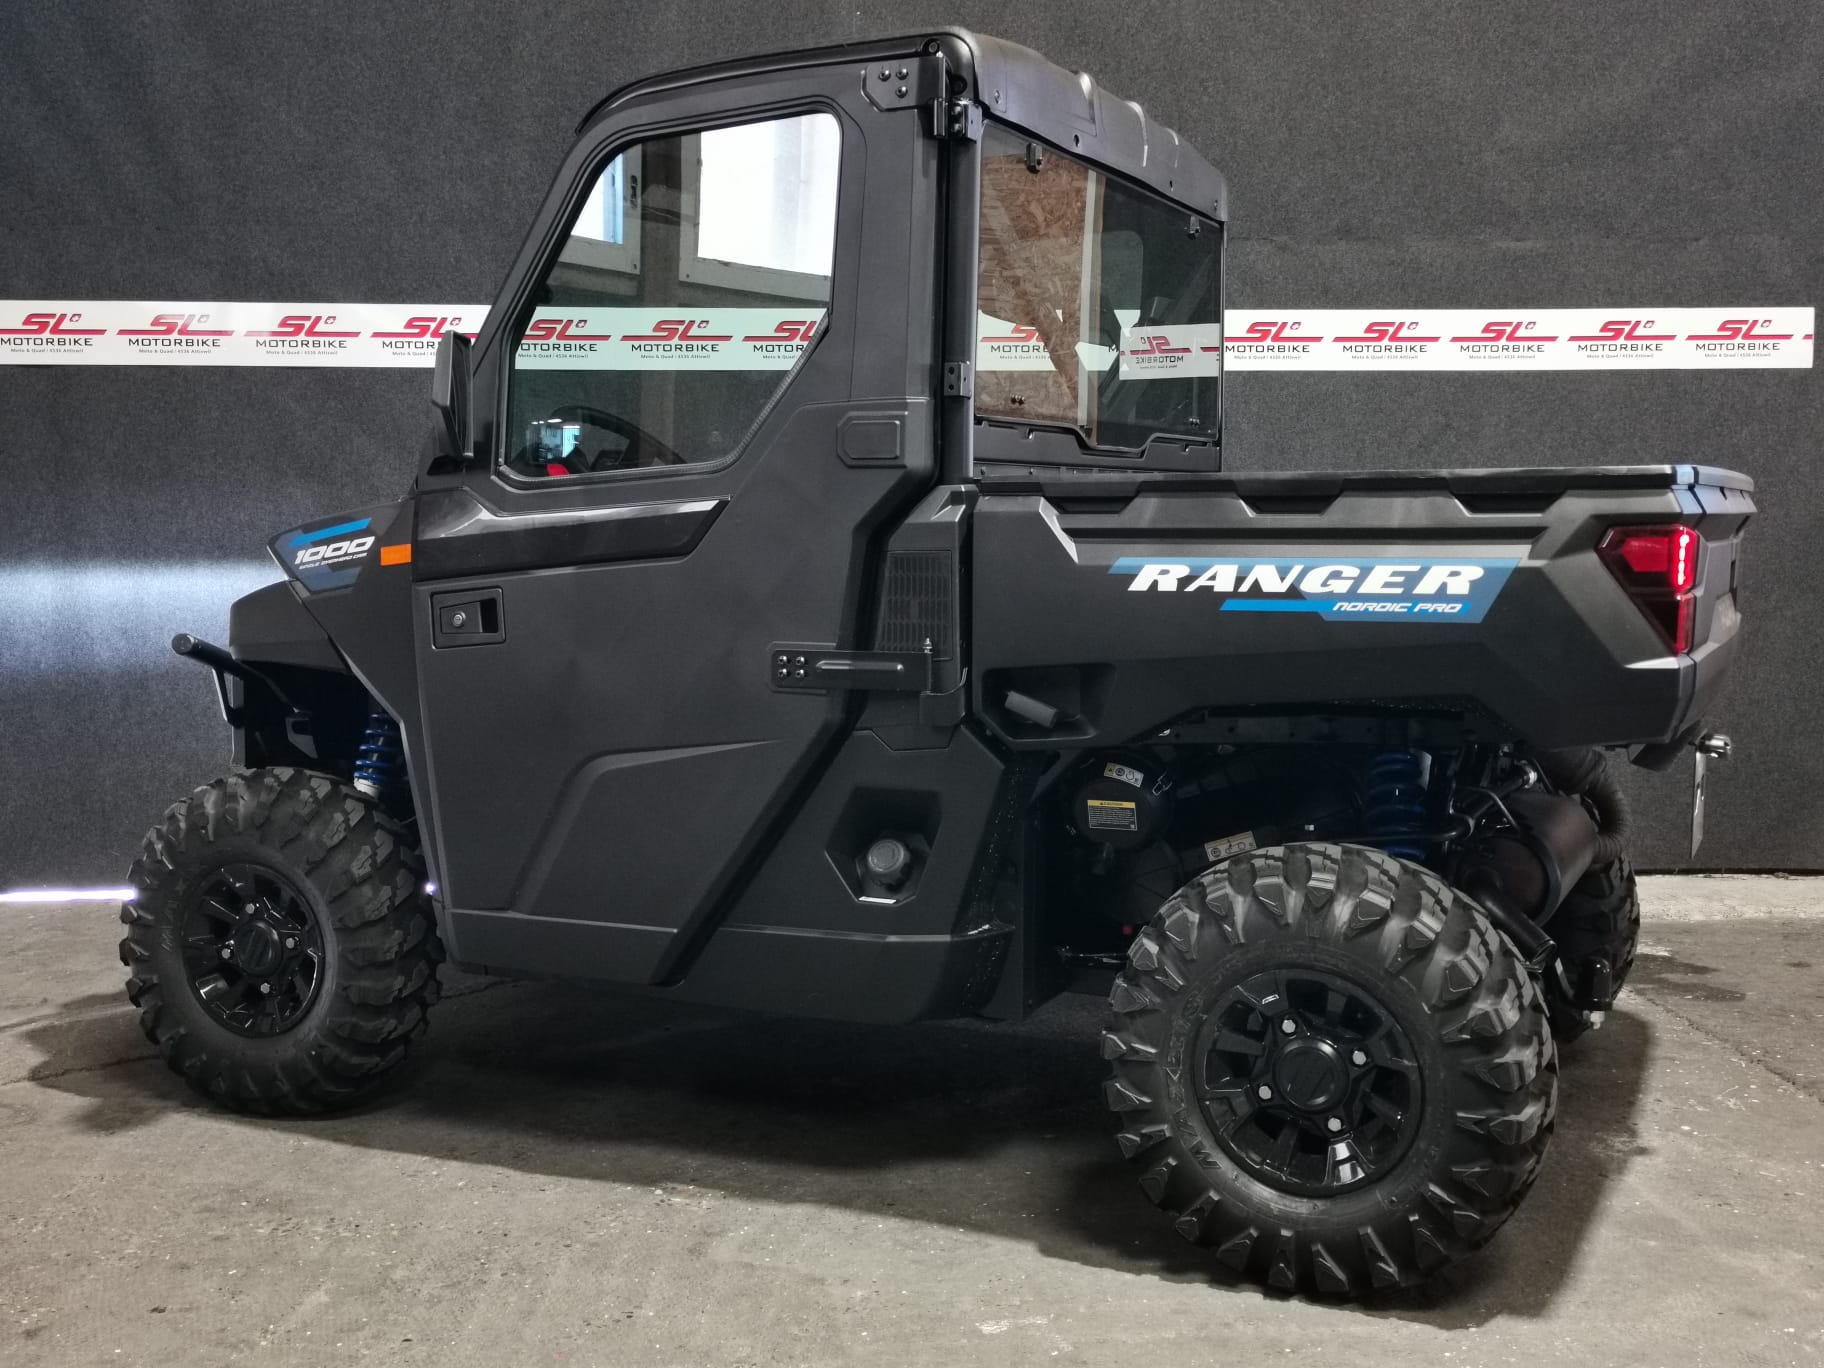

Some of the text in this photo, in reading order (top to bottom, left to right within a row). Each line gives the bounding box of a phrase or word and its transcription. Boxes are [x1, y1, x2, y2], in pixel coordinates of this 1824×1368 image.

[0, 338, 93, 346] MOTORBIKE
[129, 338, 221, 347] MOTORBIKE
[256, 339, 348, 348] MOTORBIKE
[382, 341, 435, 349] MOTOR
[520, 343, 598, 352] OTORBIKE
[631, 344, 720, 352] MOTORBIKE
[753, 345, 804, 353] MOTOR
[991, 345, 1049, 353] MOTOR
[1225, 345, 1310, 353] MOTORBIKE
[1343, 345, 1427, 353] MOTORBIKE
[1460, 345, 1544, 353] MOTORBIKE
[1578, 344, 1663, 352] MOTORBIKE
[1696, 343, 1780, 351] MOTORBIKE
[294, 536, 375, 565] 1000
[1128, 564, 1484, 595] RANGER
[1333, 602, 1463, 613] NORDIC PRO
